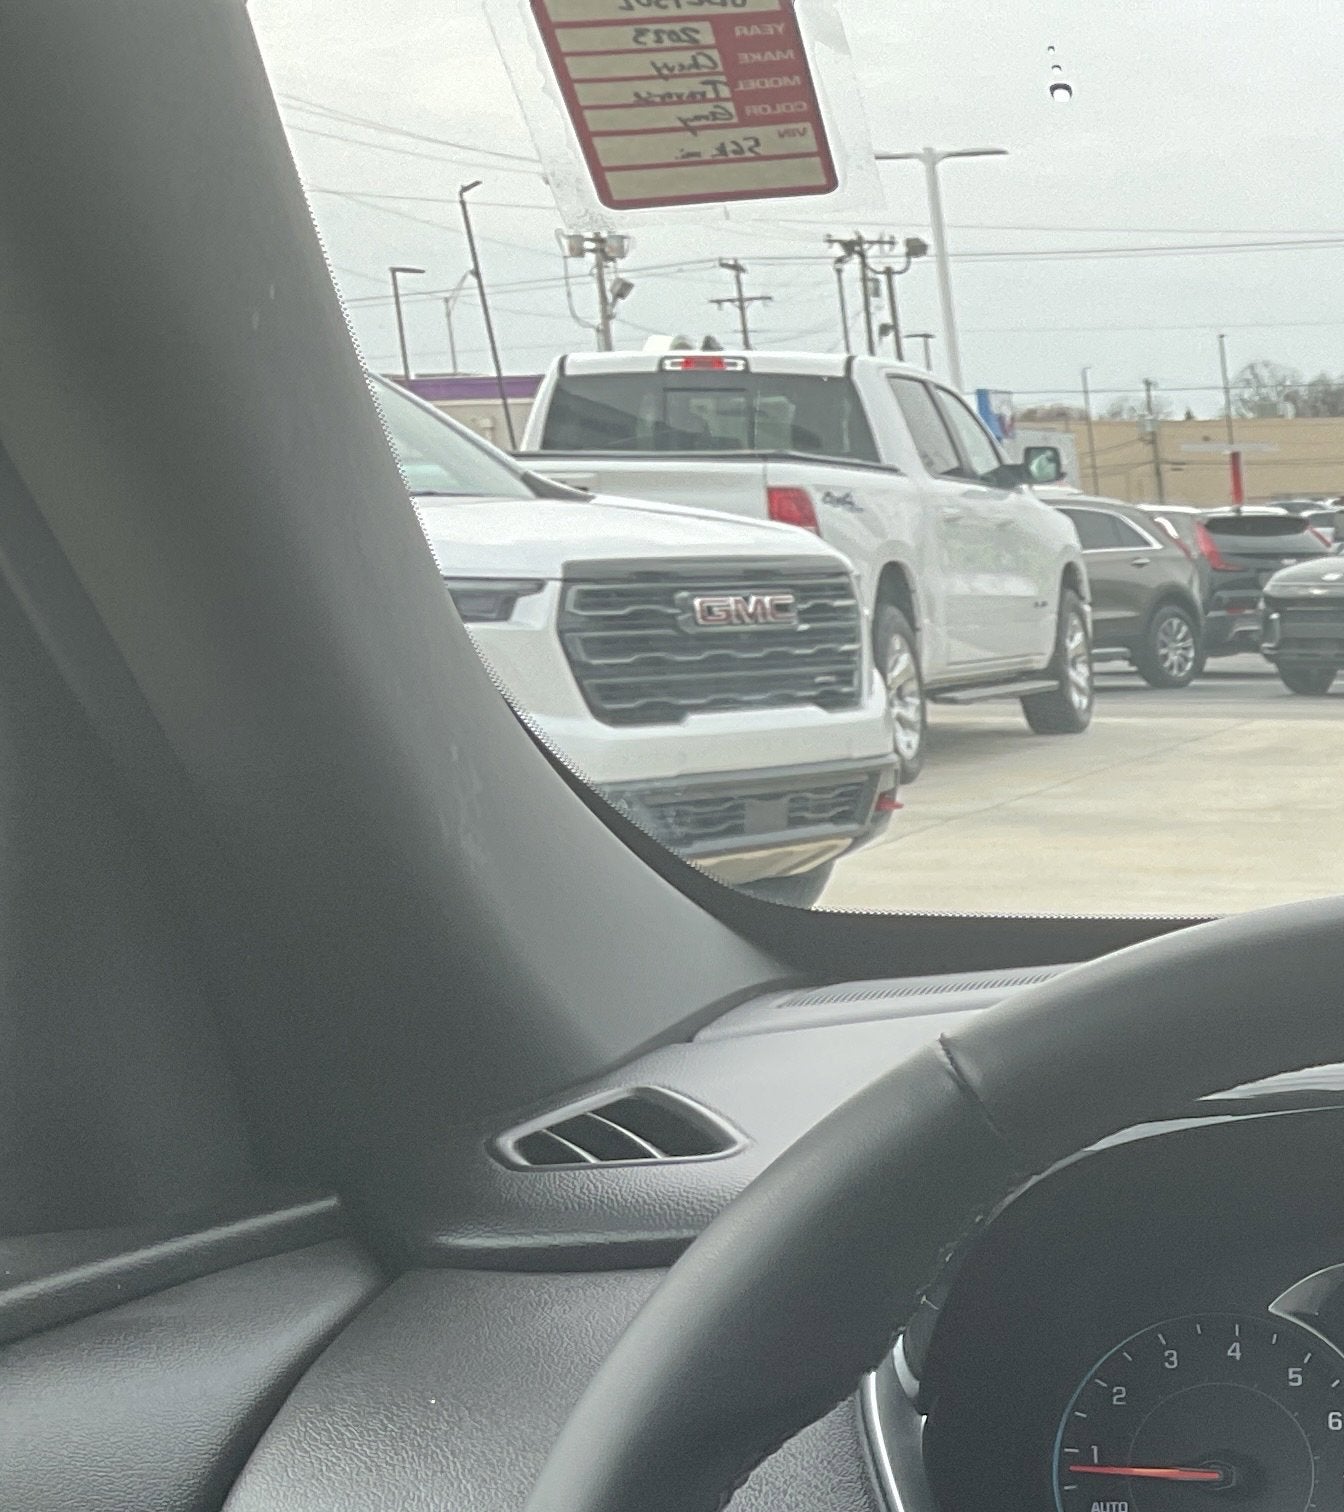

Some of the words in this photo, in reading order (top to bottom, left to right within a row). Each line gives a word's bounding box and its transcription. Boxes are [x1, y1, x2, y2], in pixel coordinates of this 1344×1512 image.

[693, 595, 796, 624] GMC
[1164, 1351, 1178, 1369] 3
[1227, 1342, 1242, 1361] 4
[1288, 1368, 1303, 1387] 5
[1112, 1387, 1127, 1405] 2
[1327, 1413, 1343, 1431] 6
[1090, 1446, 1099, 1463] 1
